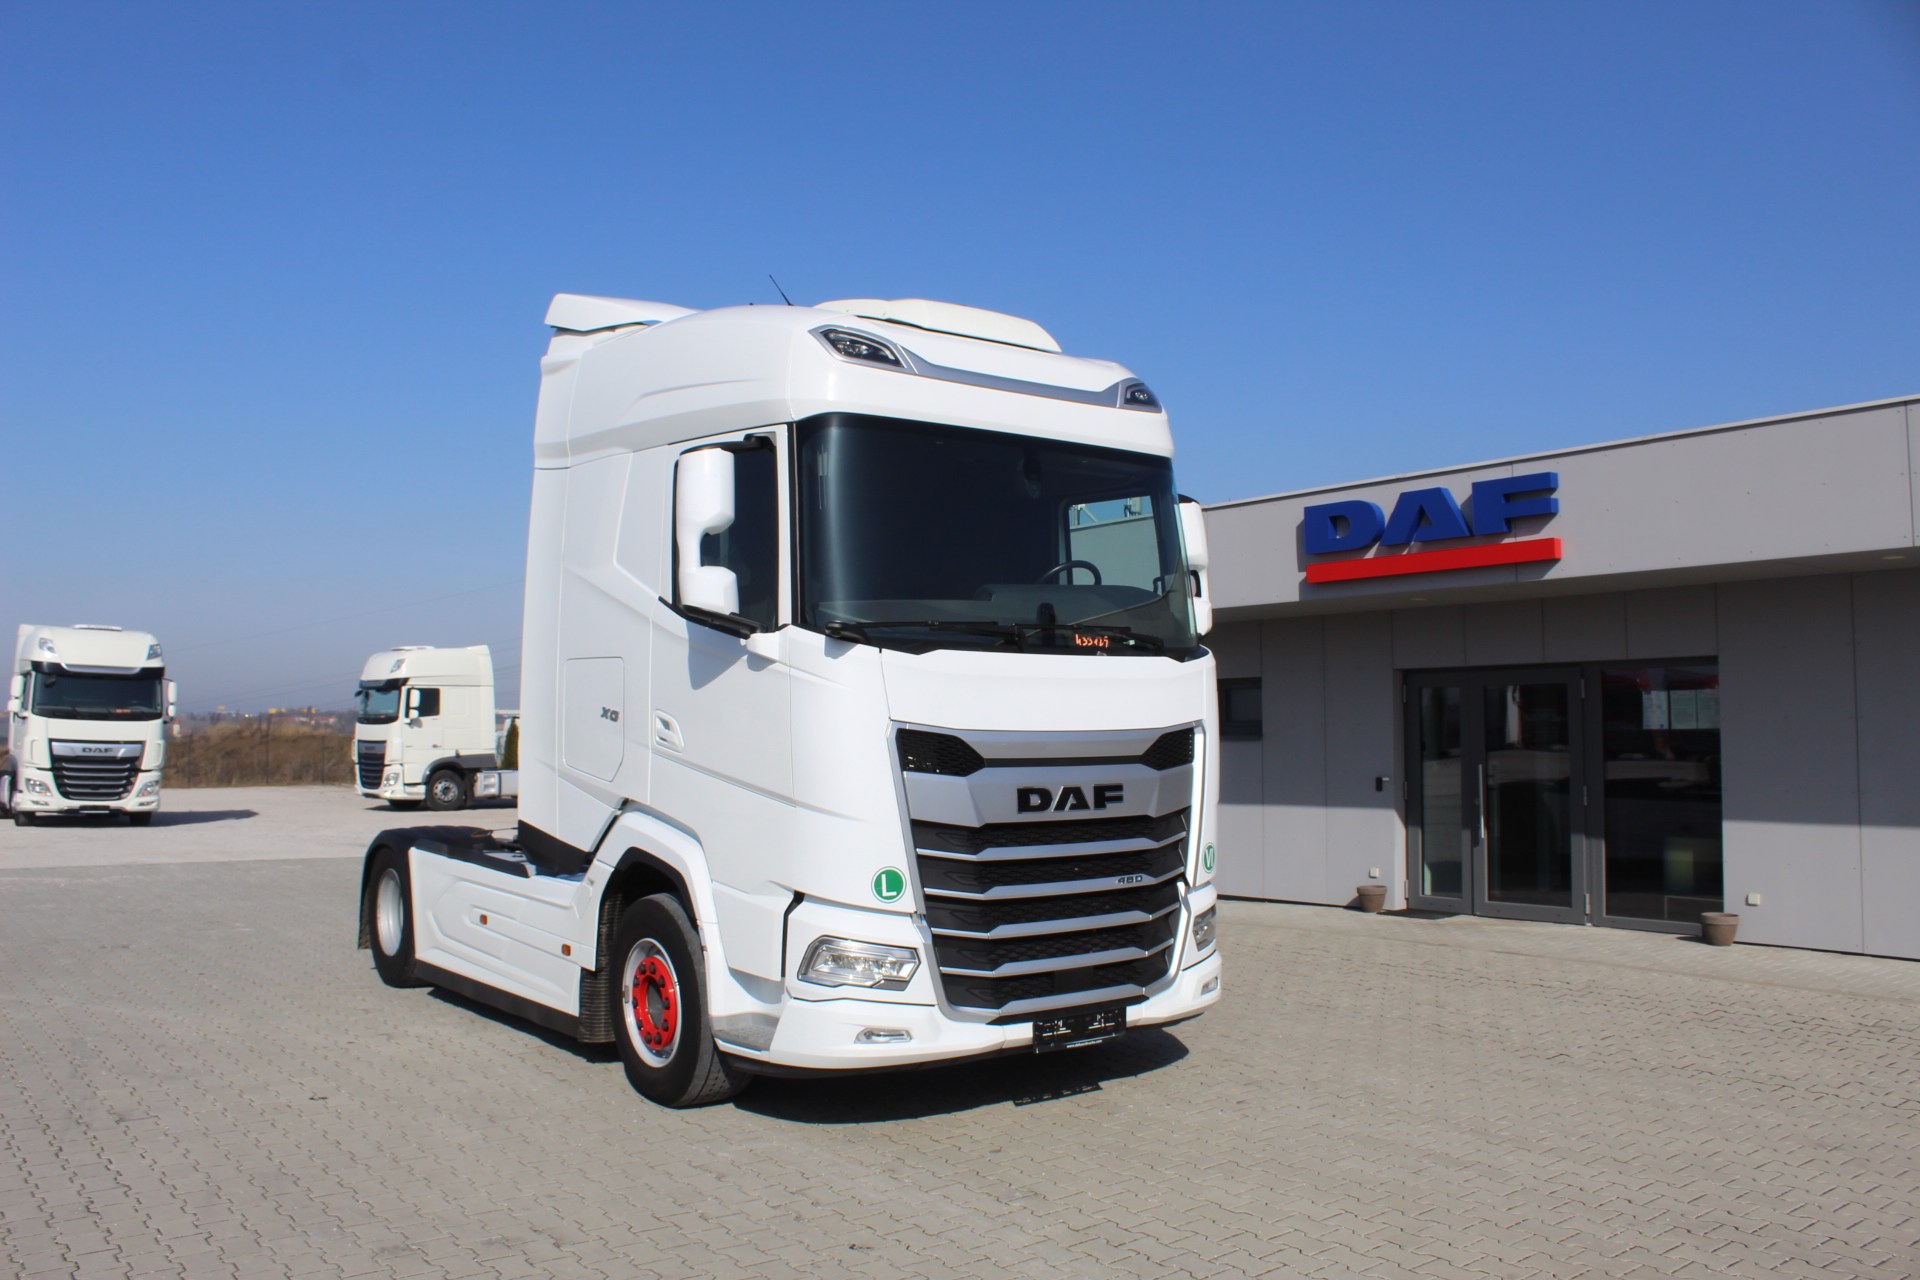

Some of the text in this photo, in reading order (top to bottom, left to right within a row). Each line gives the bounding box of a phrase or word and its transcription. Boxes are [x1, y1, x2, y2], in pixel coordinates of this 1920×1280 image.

[1304, 471, 1559, 555] DAF
[1016, 782, 1124, 814] DAF
[881, 873, 898, 897] L
[1117, 874, 1143, 885] 480
